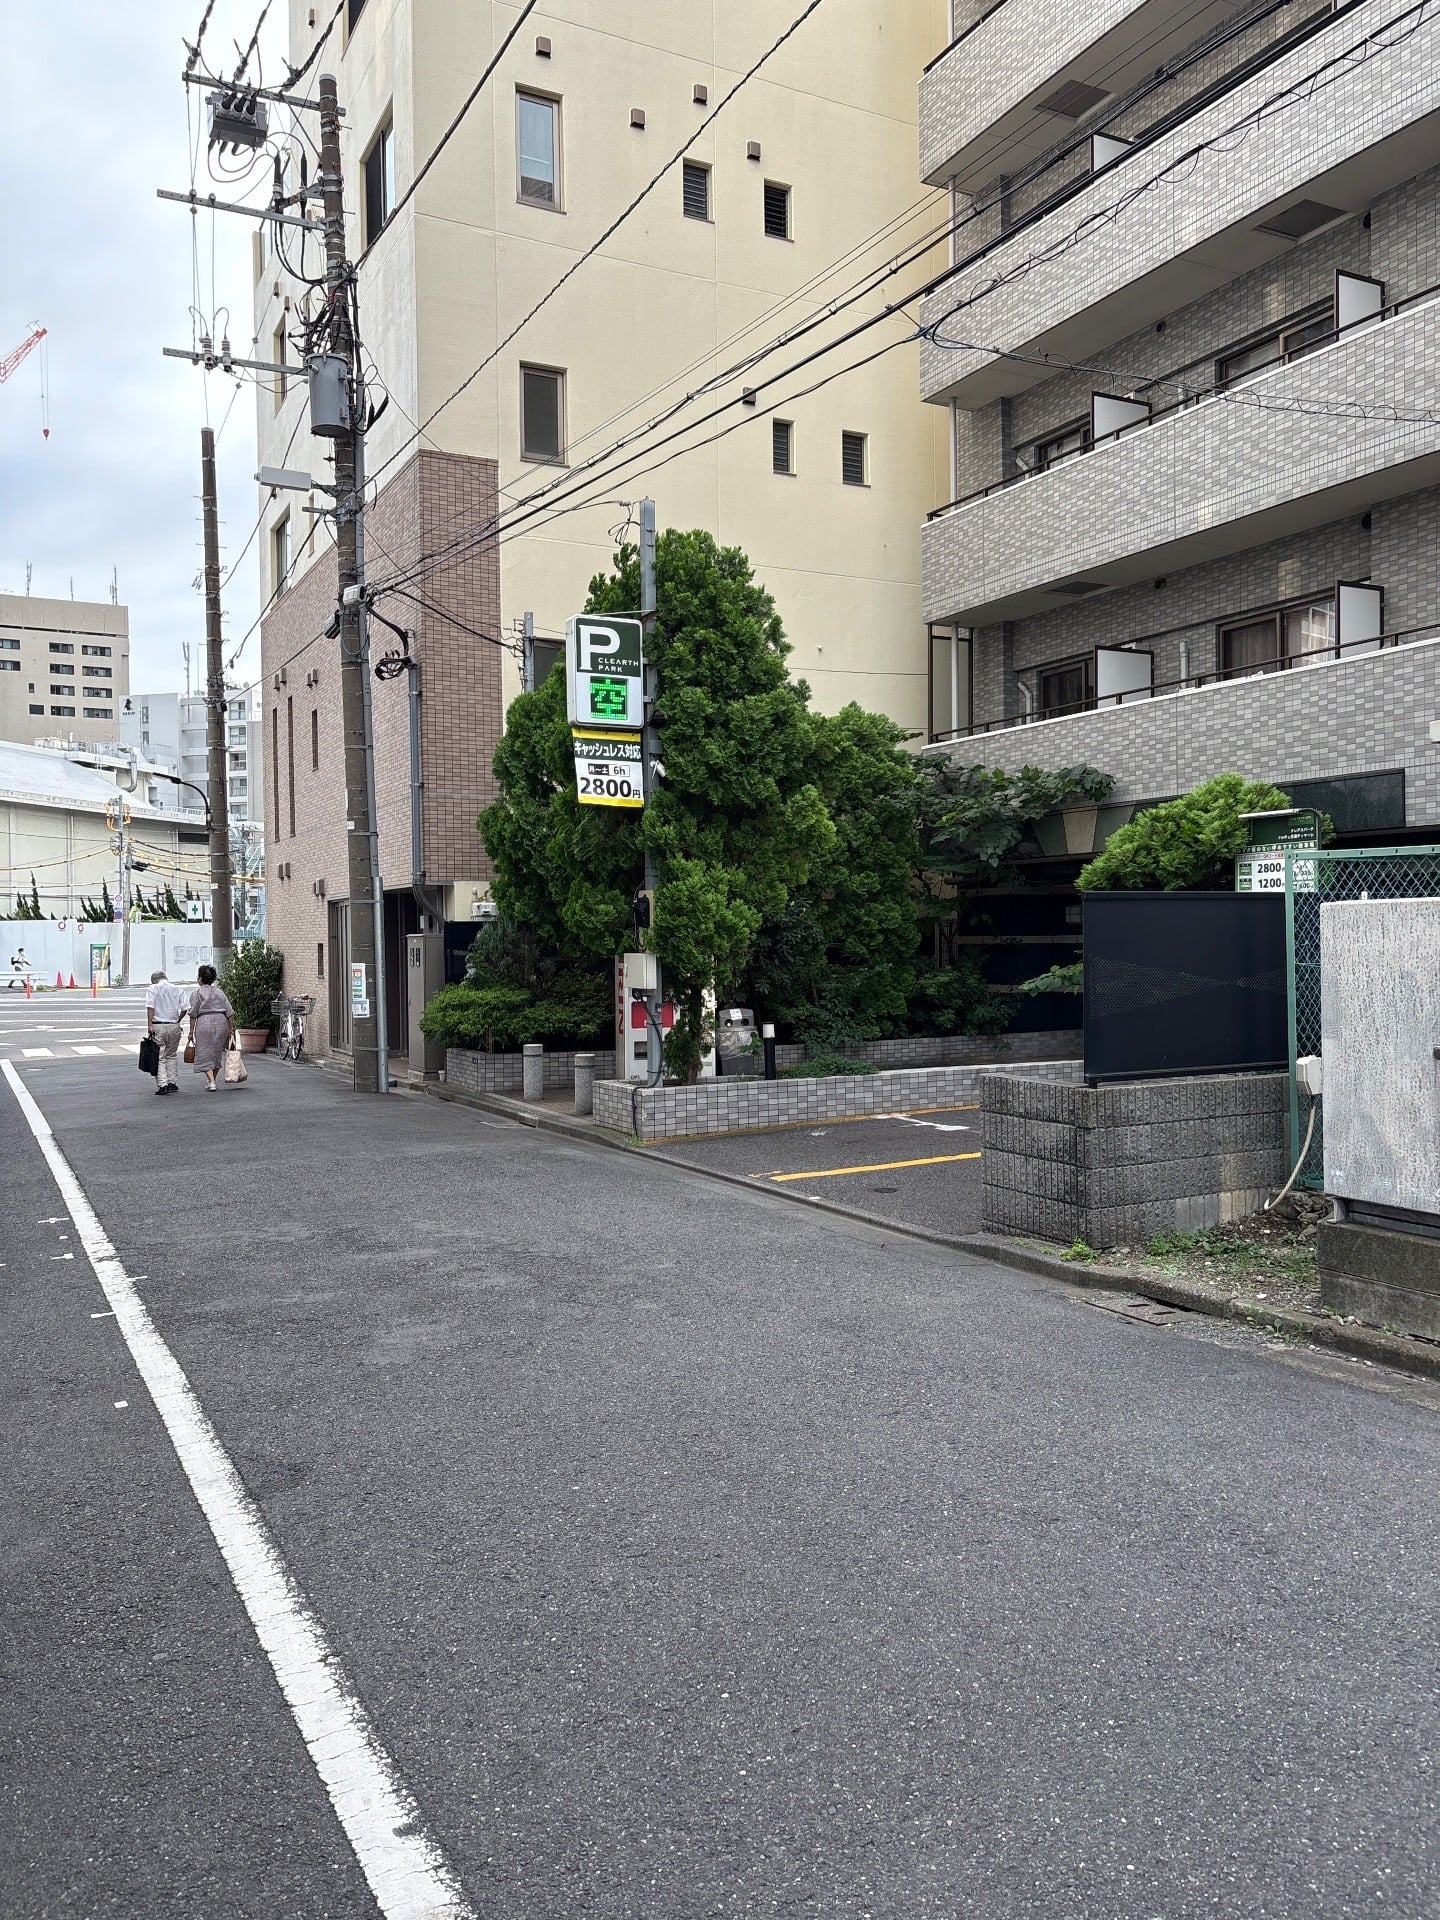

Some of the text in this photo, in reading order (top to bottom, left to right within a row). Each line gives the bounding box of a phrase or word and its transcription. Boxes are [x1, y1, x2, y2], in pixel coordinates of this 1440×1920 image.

[579, 625, 620, 670] P
[598, 657, 639, 667] CLEARTH
[598, 665, 623, 673] PARK
[574, 741, 641, 759] キャッシュレス対応
[613, 766, 626, 776] 6h
